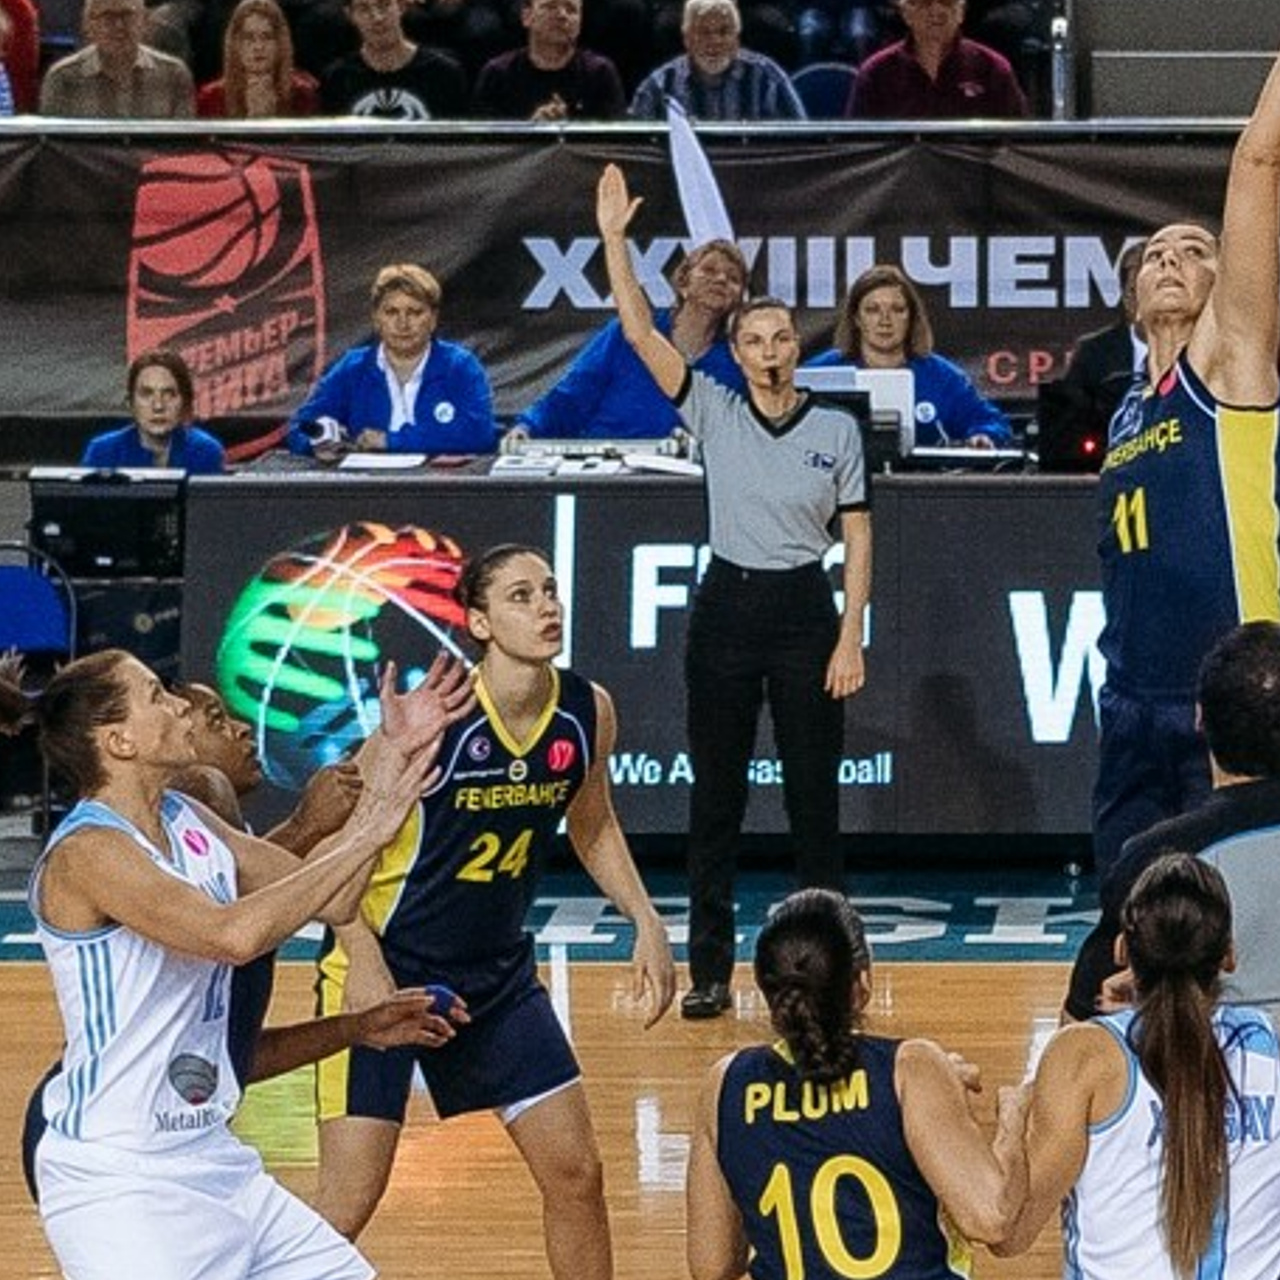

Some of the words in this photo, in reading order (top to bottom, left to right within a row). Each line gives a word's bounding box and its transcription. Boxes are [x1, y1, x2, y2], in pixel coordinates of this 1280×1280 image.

[520, 235, 876, 308] XXIII
[1113, 486, 1148, 554] 11
[607, 753, 663, 785] We
[455, 829, 534, 883] 24
[745, 1069, 870, 1124] PLUM
